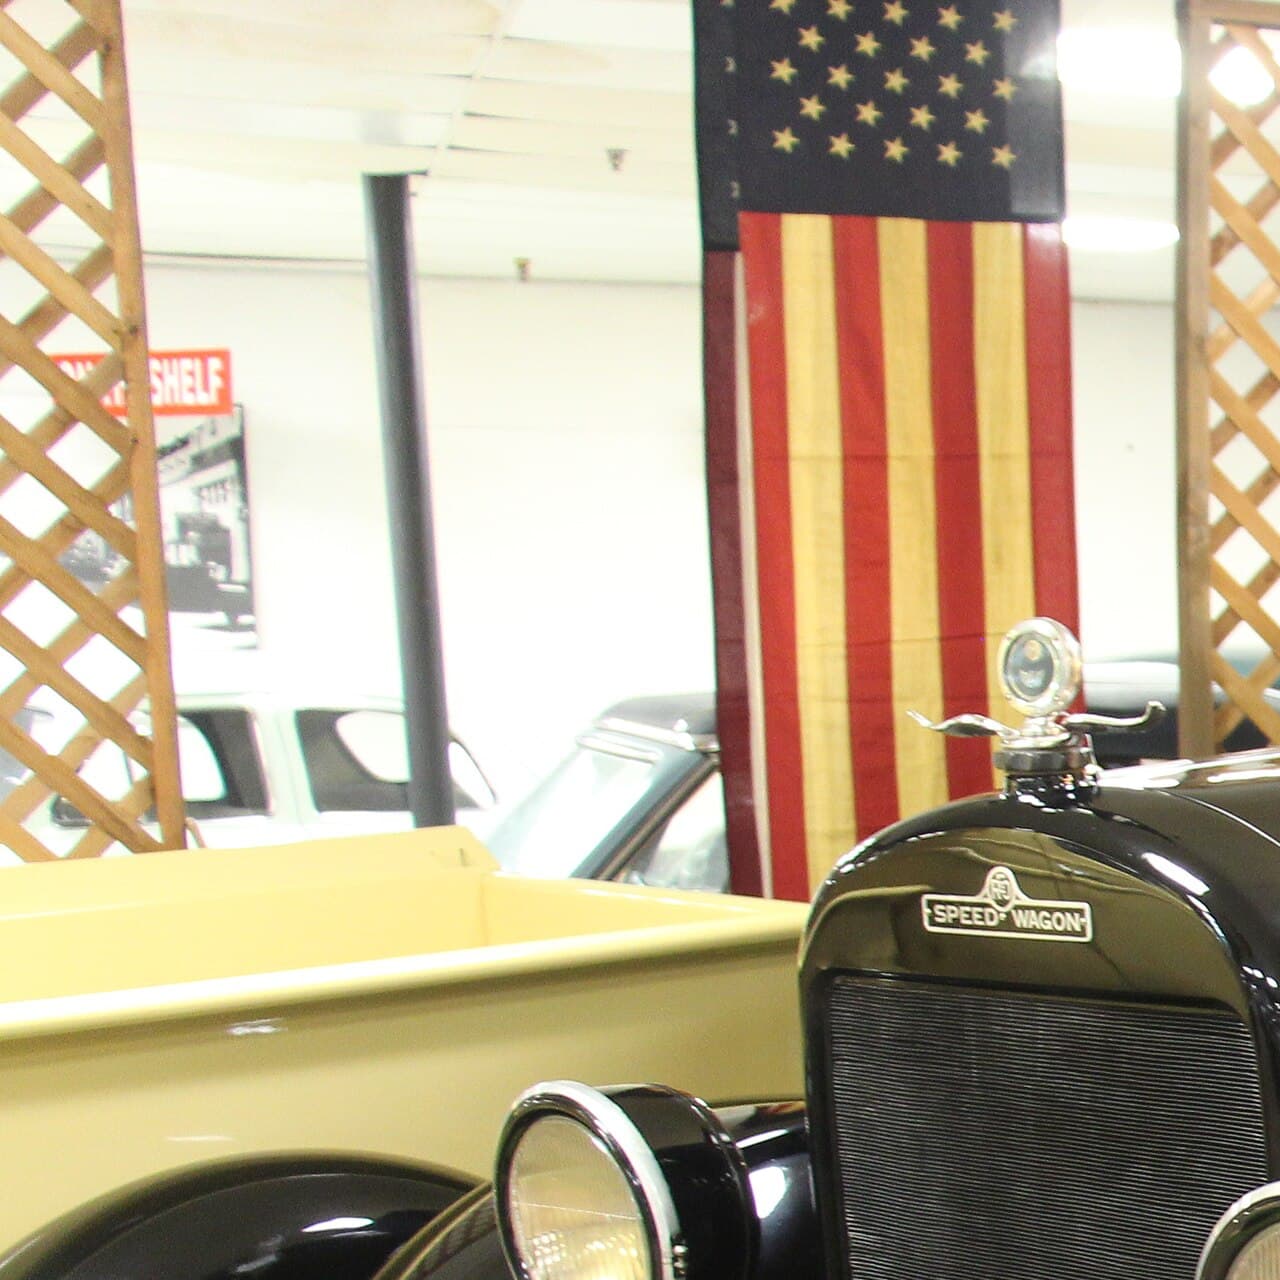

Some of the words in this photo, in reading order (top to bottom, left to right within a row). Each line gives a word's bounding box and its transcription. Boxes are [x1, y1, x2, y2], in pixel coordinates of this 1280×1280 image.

[149, 355, 225, 405] SHELF
[932, 904, 1000, 927] SPEED
[1011, 909, 1082, 932] WAGON
